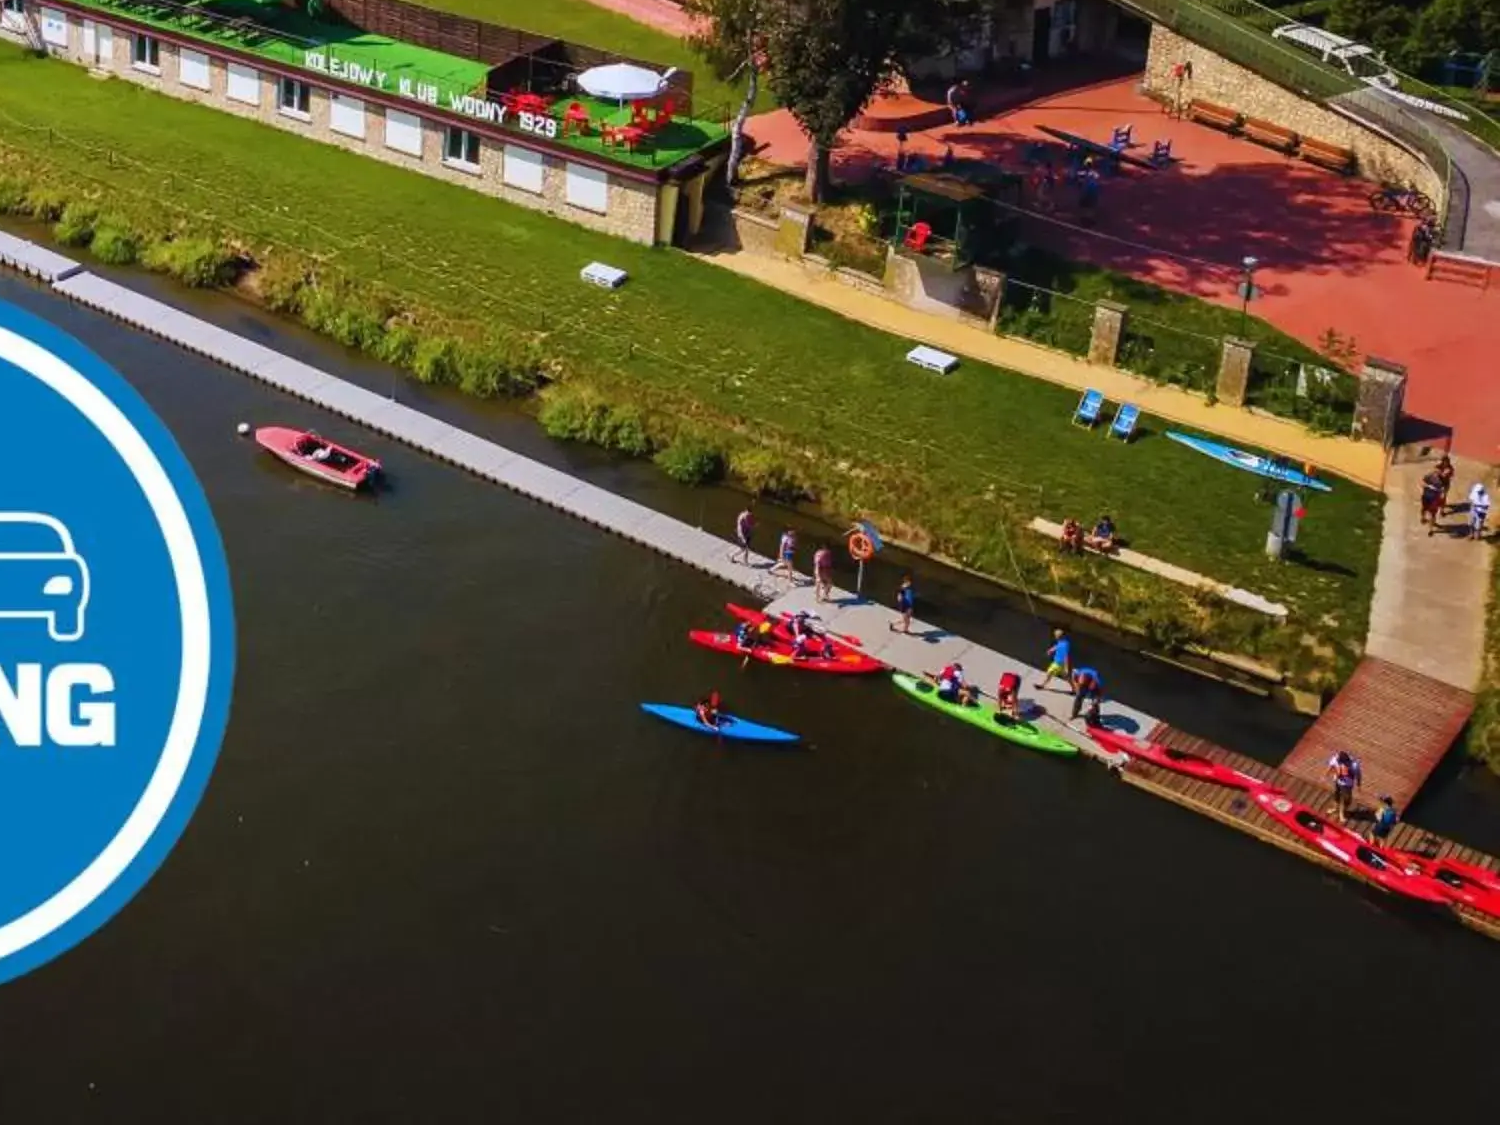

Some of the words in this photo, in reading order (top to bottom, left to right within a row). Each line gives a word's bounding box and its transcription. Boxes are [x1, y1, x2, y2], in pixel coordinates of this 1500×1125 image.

[305, 51, 387, 87] KOLEJOWY
[399, 78, 438, 106] KLUB
[449, 91, 507, 123] WODNY
[518, 111, 557, 138] 1929
